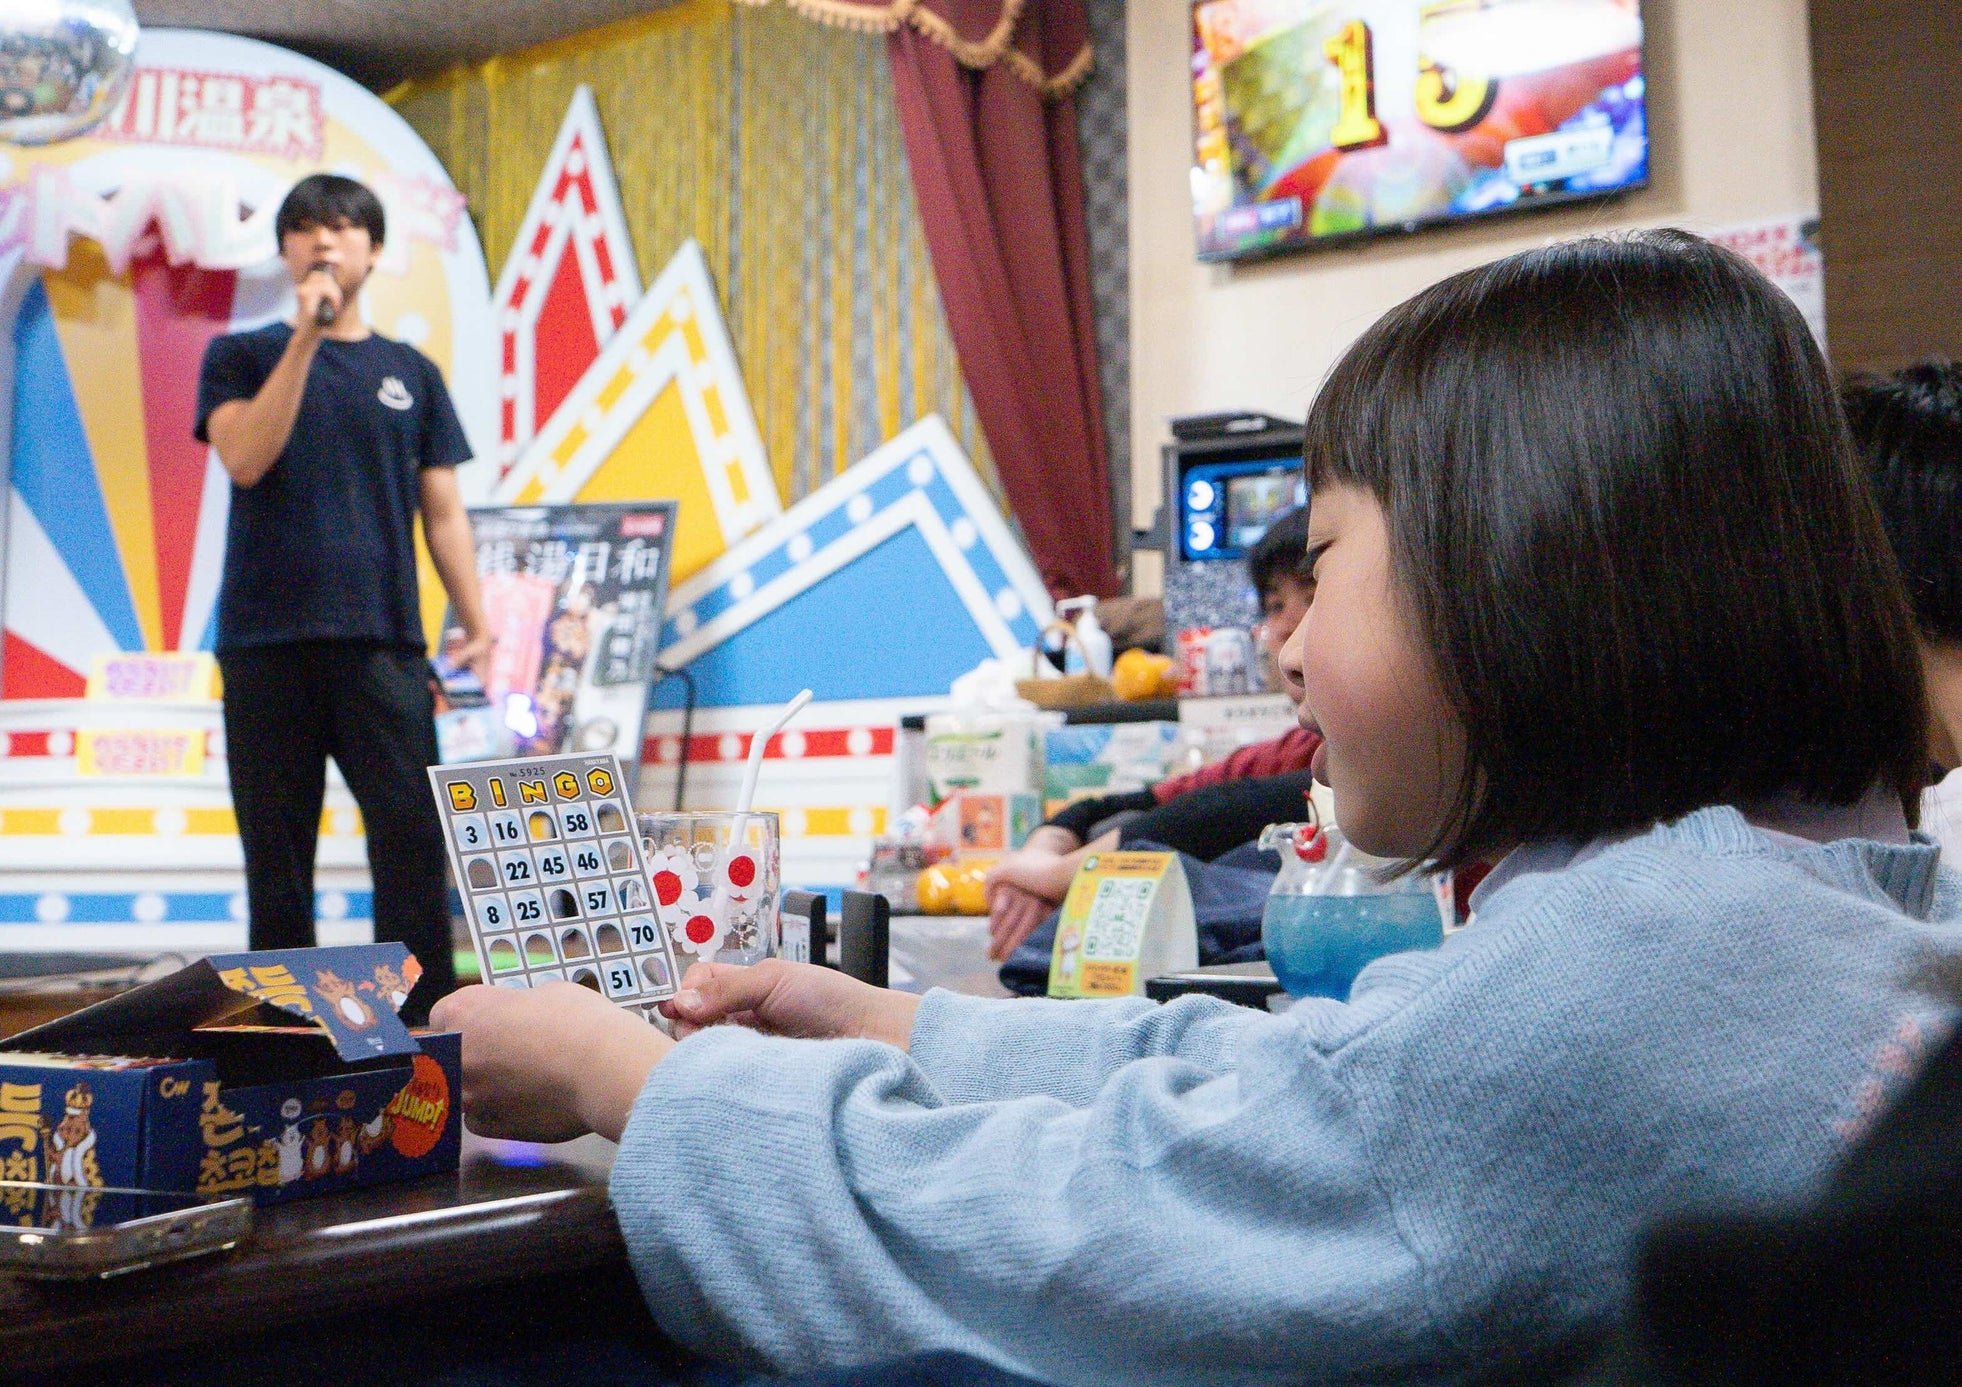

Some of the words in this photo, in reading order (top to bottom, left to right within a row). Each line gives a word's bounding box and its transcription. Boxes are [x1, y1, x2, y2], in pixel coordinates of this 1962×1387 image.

[447, 768, 614, 811] BINGO
[465, 825, 479, 844] 3
[495, 821, 519, 841] 16
[566, 813, 589, 833] 58
[505, 860, 531, 881] 22
[542, 856, 565, 875] 45
[577, 852, 599, 871] 46
[486, 905, 500, 924] 8
[516, 900, 541, 921] 25
[587, 890, 608, 911] 57
[631, 925, 655, 945] 70
[610, 969, 634, 990] 51
